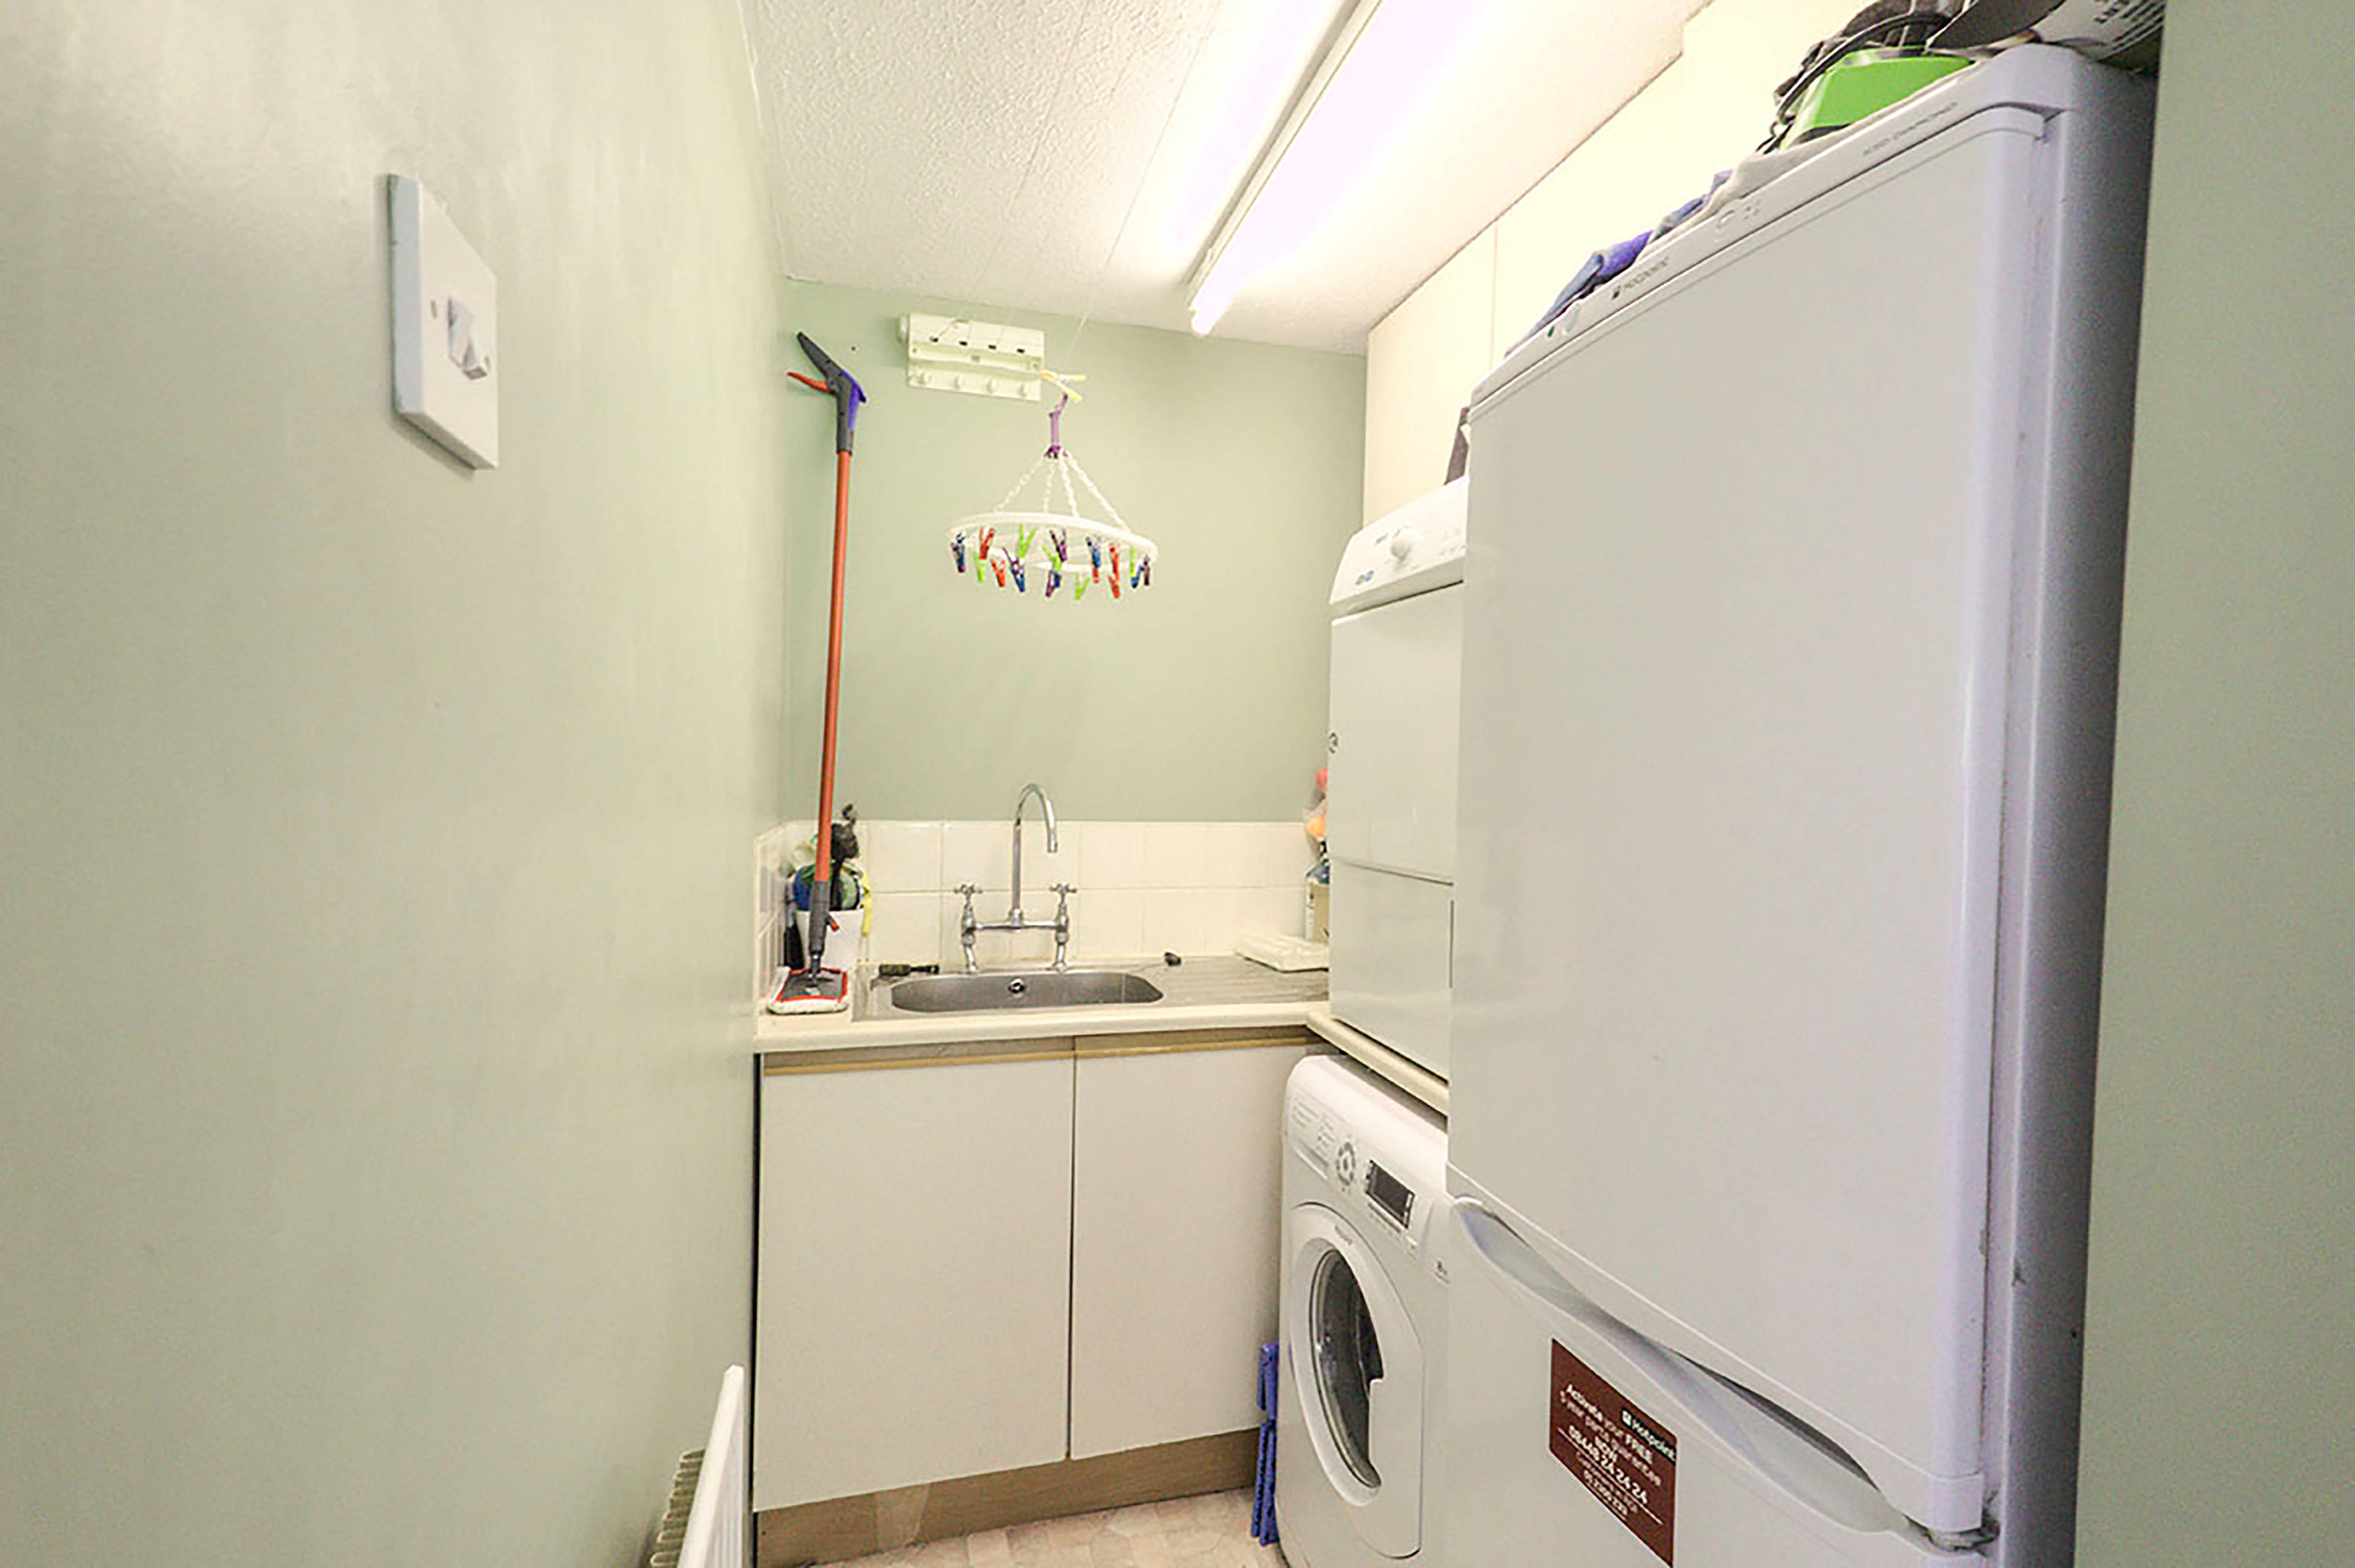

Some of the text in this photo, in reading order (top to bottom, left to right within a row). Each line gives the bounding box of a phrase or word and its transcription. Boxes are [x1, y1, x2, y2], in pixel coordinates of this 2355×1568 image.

[1566, 1384, 1603, 1422] Activate
[1626, 1434, 1653, 1465] FREE
[1632, 1418, 1676, 1463] Hotpoint
[1601, 1454, 1615, 1475] 24
[1616, 1468, 1631, 1490] 24
[1632, 1482, 1648, 1504] 24
